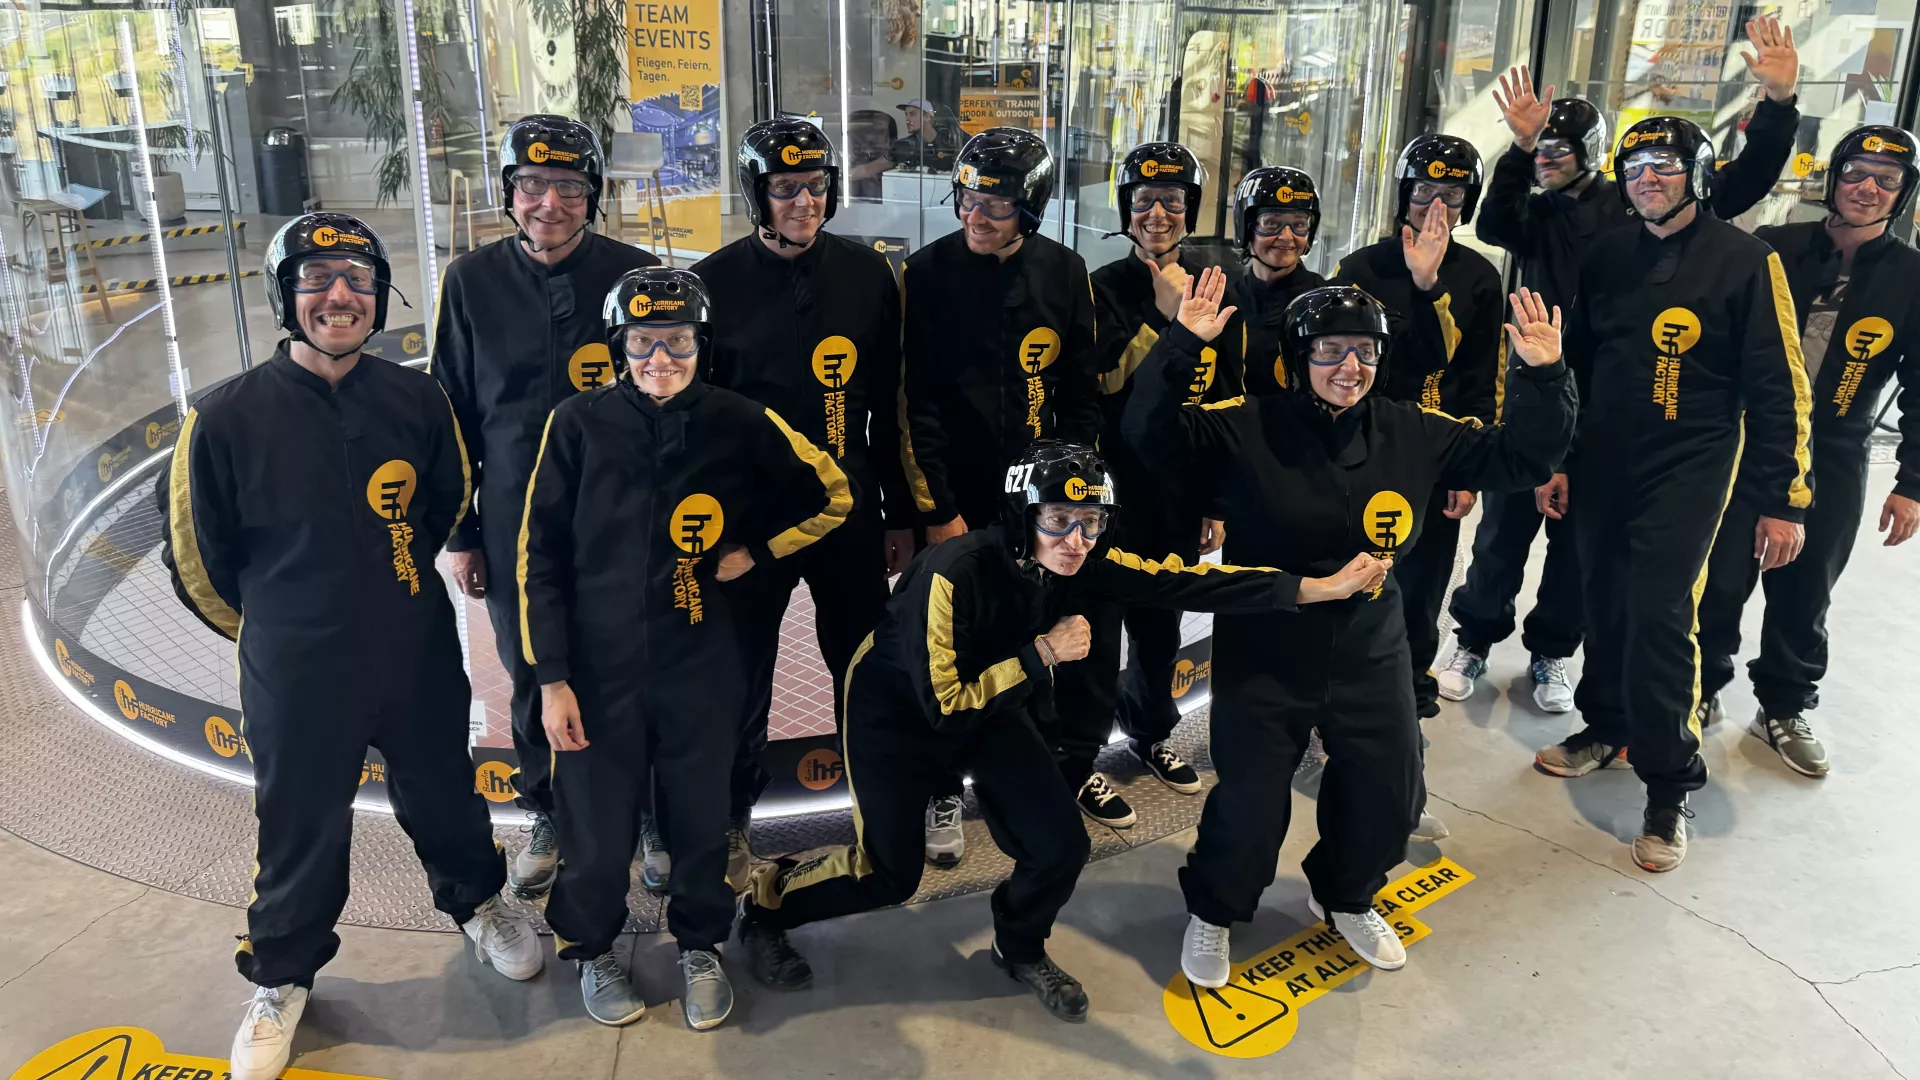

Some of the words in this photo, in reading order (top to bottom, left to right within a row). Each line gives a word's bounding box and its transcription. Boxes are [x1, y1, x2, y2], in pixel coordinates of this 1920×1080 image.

[635, 4, 688, 24] TEAM
[635, 28, 711, 50] EVENTS
[636, 57, 675, 70] Fliegen,
[677, 59, 712, 71] Feiern,
[637, 70, 670, 83] Tagen.
[996, 110, 1035, 118] OUTDOOR
[1653, 355, 1669, 406] FACTORY
[1665, 357, 1681, 420] HURRICANE
[1832, 361, 1857, 406] FACTORY
[1836, 362, 1868, 417] HURRICANE
[823, 392, 837, 446] FACTORY
[835, 390, 846, 460] HURRICANE
[1004, 463, 1035, 494] 627
[387, 522, 410, 582] FACTORY
[138, 700, 177, 723] HURRICANE
[140, 709, 168, 728] FACTORY
[482, 769, 490, 793] Berlin
[1240, 949, 1296, 986] KEEP
[1396, 867, 1461, 903] CLEAR
[1285, 972, 1315, 999] AT
[1313, 953, 1360, 982] ALL
